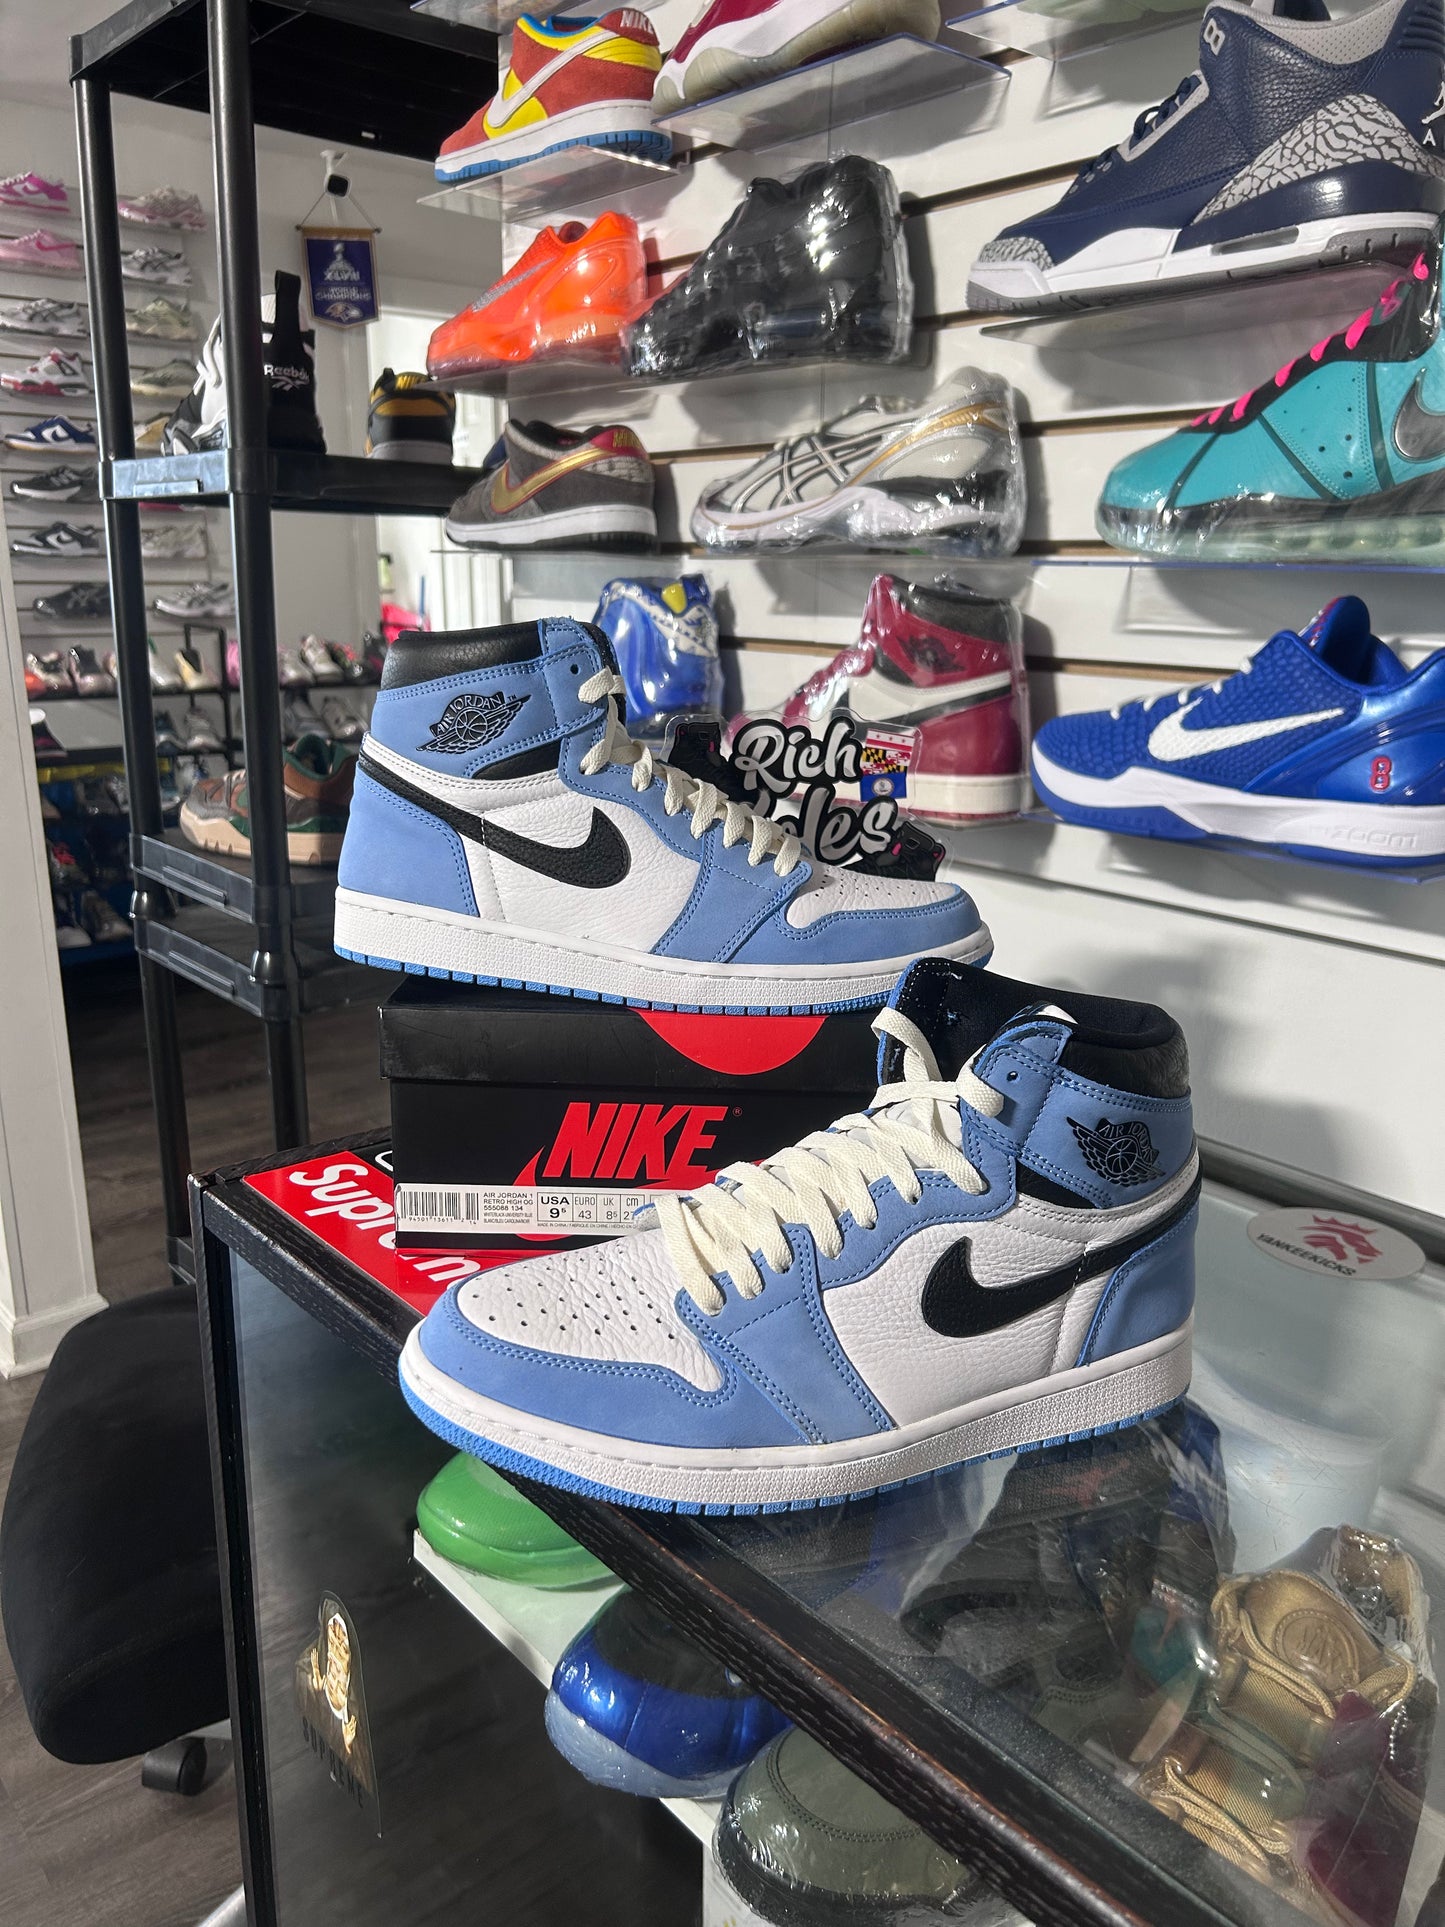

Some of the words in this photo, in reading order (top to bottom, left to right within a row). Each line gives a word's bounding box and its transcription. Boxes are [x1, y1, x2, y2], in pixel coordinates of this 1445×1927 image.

[437, 713, 454, 735] AIR
[451, 695, 502, 712] JORDAN
[733, 722, 857, 794] Rich
[752, 786, 895, 862] les
[541, 1101, 729, 1180] NIKE
[1098, 1124, 1124, 1138] AIR
[540, 1196, 570, 1206] USA
[574, 1196, 596, 1206] EURO
[603, 1197, 615, 1206] UK
[578, 1210, 592, 1219] 43
[1257, 1233, 1357, 1276] YANKEEKICKS
